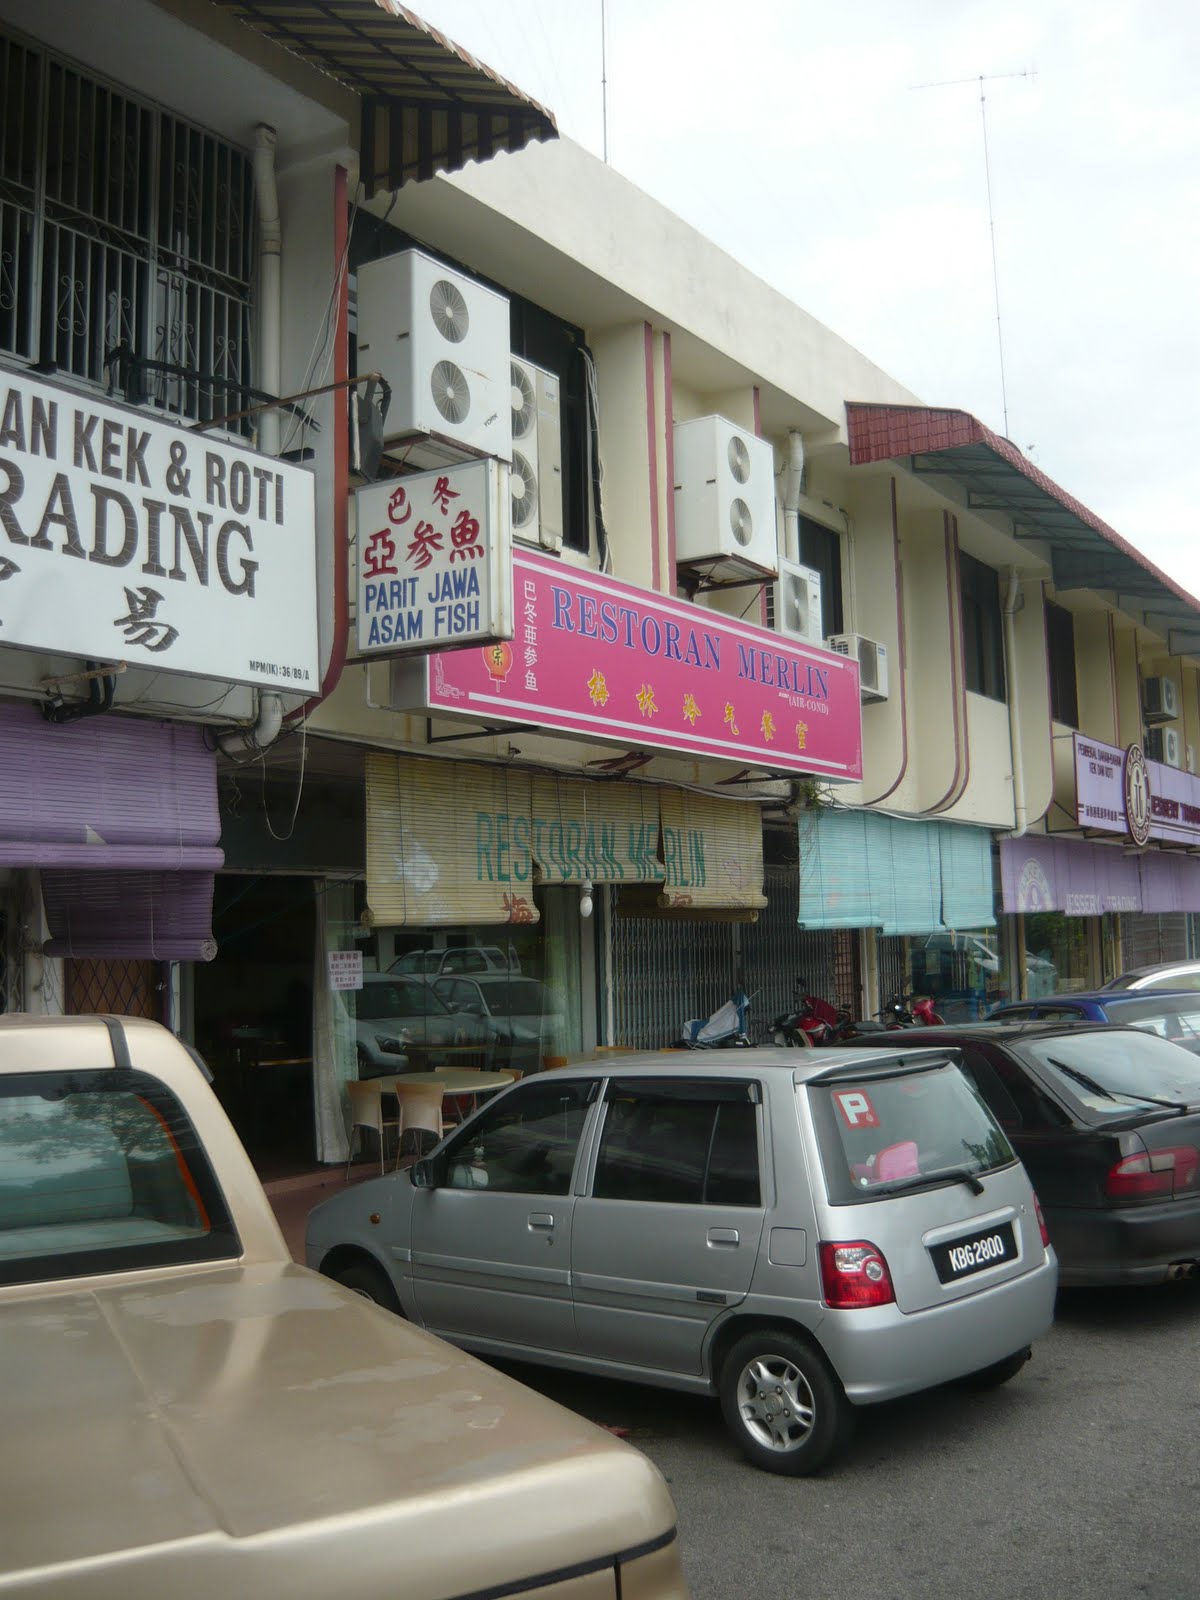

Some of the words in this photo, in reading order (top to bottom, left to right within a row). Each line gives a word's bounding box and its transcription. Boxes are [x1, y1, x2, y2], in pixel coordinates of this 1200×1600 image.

[73, 409, 152, 487] KEK
[166, 440, 191, 498] &
[205, 451, 284, 525] ROTI
[387, 476, 461, 525] 巴冬
[365, 577, 419, 613] PARIT
[428, 566, 480, 604] JAWA
[368, 609, 423, 646] ASAM
[434, 600, 479, 637] FISH
[551, 586, 721, 672] RESTORAN
[736, 642, 829, 700] MERLIN
[788, 694, 829, 716] (AIR-COND)
[475, 811, 624, 882] RESTORAN
[838, 1093, 869, 1124] P
[948, 1234, 1004, 1272] KBG2800
